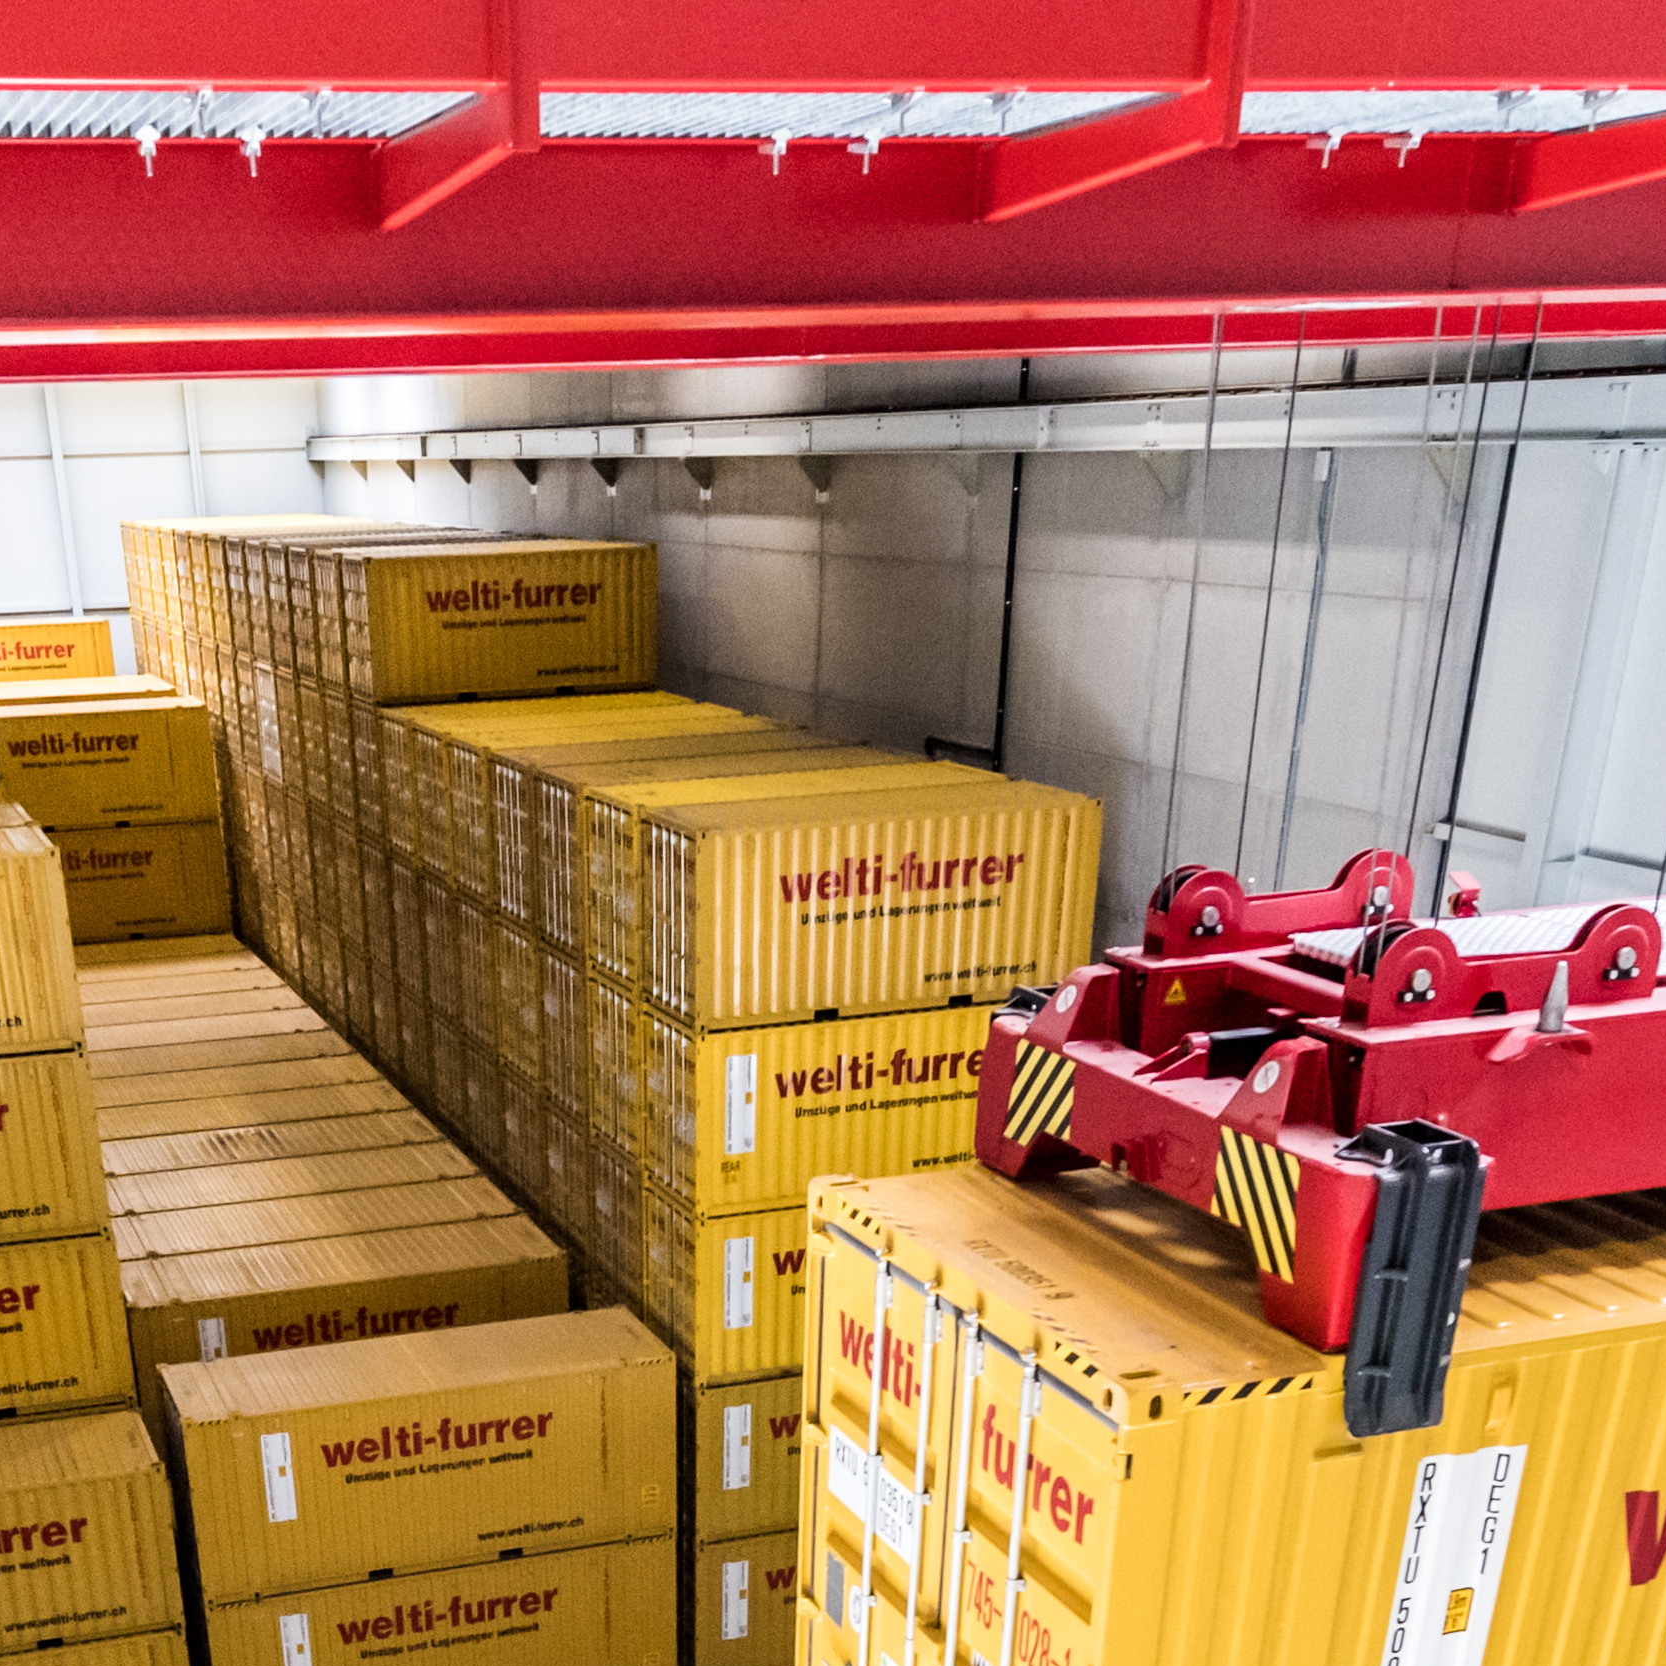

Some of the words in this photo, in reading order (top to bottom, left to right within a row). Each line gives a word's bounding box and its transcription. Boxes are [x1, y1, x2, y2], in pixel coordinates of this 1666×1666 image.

[426, 579, 602, 613] welti-furrer
[8, 732, 139, 756] welti-furrer
[66, 850, 153, 870] ti-furrer
[780, 851, 1024, 903] welti-furrer
[775, 1048, 984, 1099] welti-furre
[795, 1105, 841, 1118] Umzüge
[845, 1100, 867, 1113] und
[870, 1094, 938, 1110] Lagerungen
[252, 1302, 459, 1350] welti-furrer
[320, 1411, 553, 1468] welti-furrer
[982, 1403, 1094, 1546] furer
[1403, 1463, 1436, 1584] RXTU
[1480, 1454, 1510, 1575] DEG1
[19, 1553, 72, 1570] weltweit
[337, 1588, 558, 1645] welti-furrer
